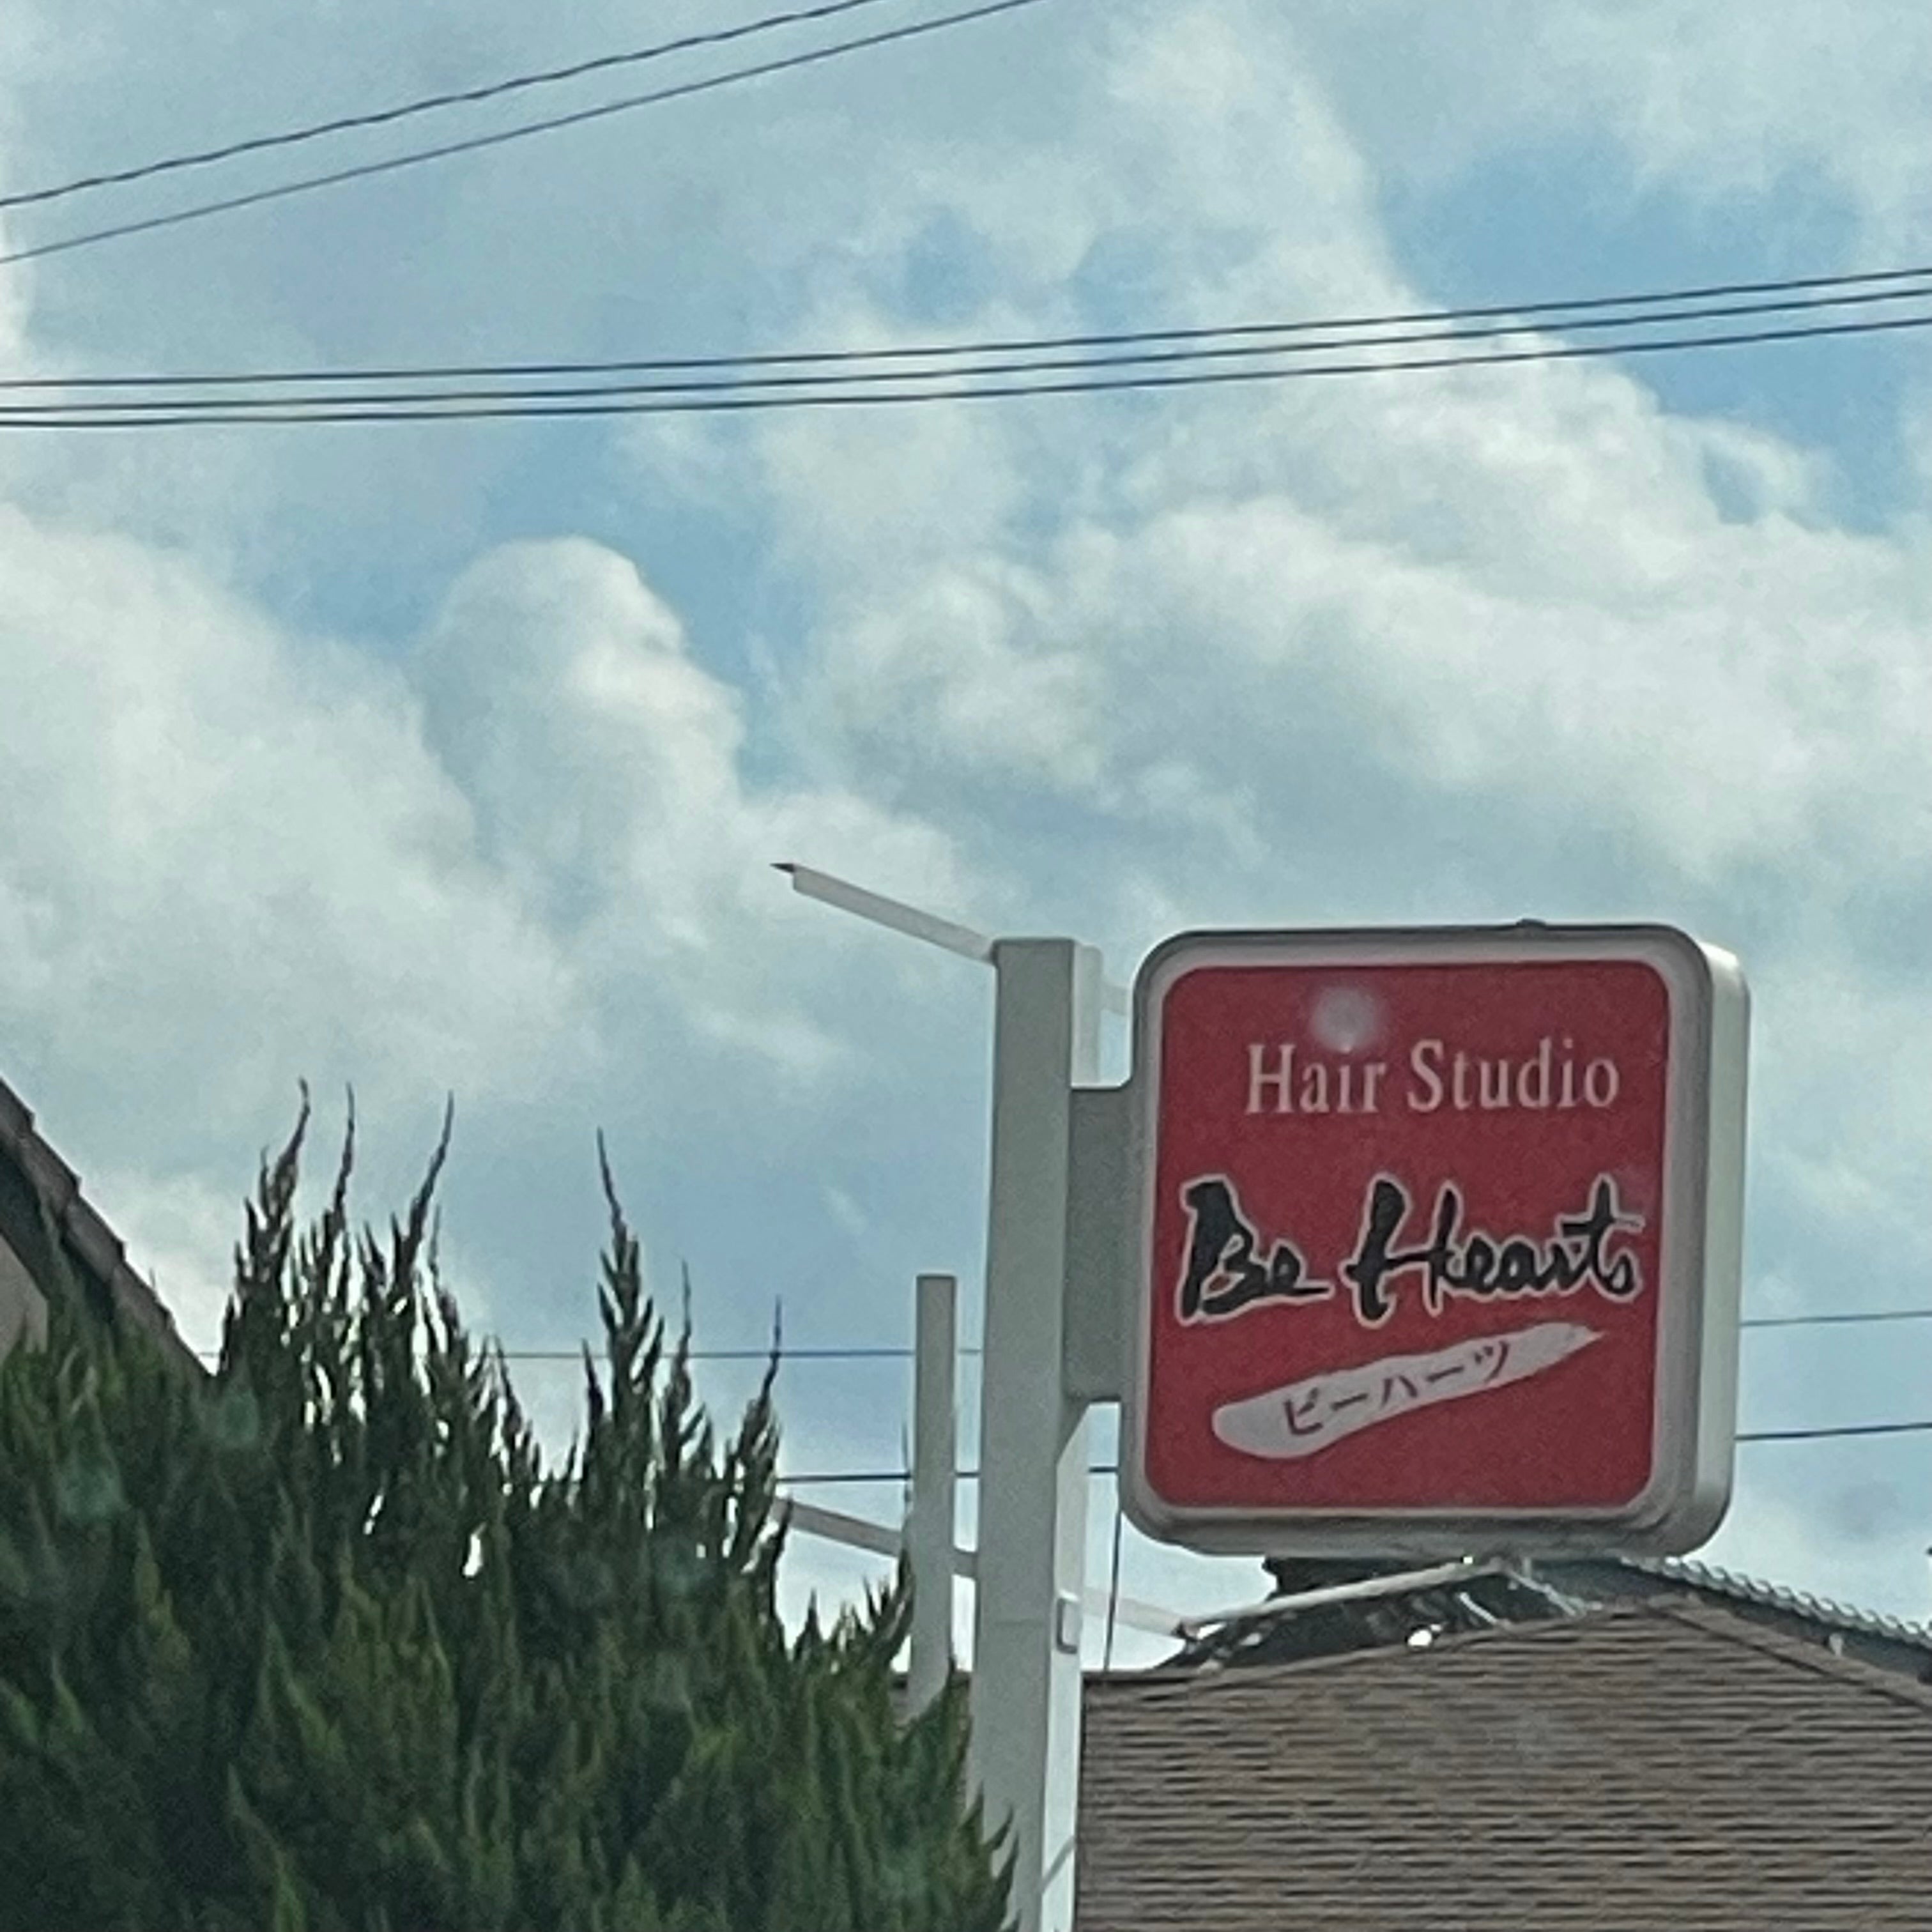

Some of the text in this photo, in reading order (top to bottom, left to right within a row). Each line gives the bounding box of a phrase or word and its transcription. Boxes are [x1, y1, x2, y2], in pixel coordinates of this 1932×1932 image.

[1246, 1038, 1619, 1114] Hair Studio
[1177, 1175, 1333, 1324] Be
[1284, 1341, 1509, 1436] ビーハーツ
